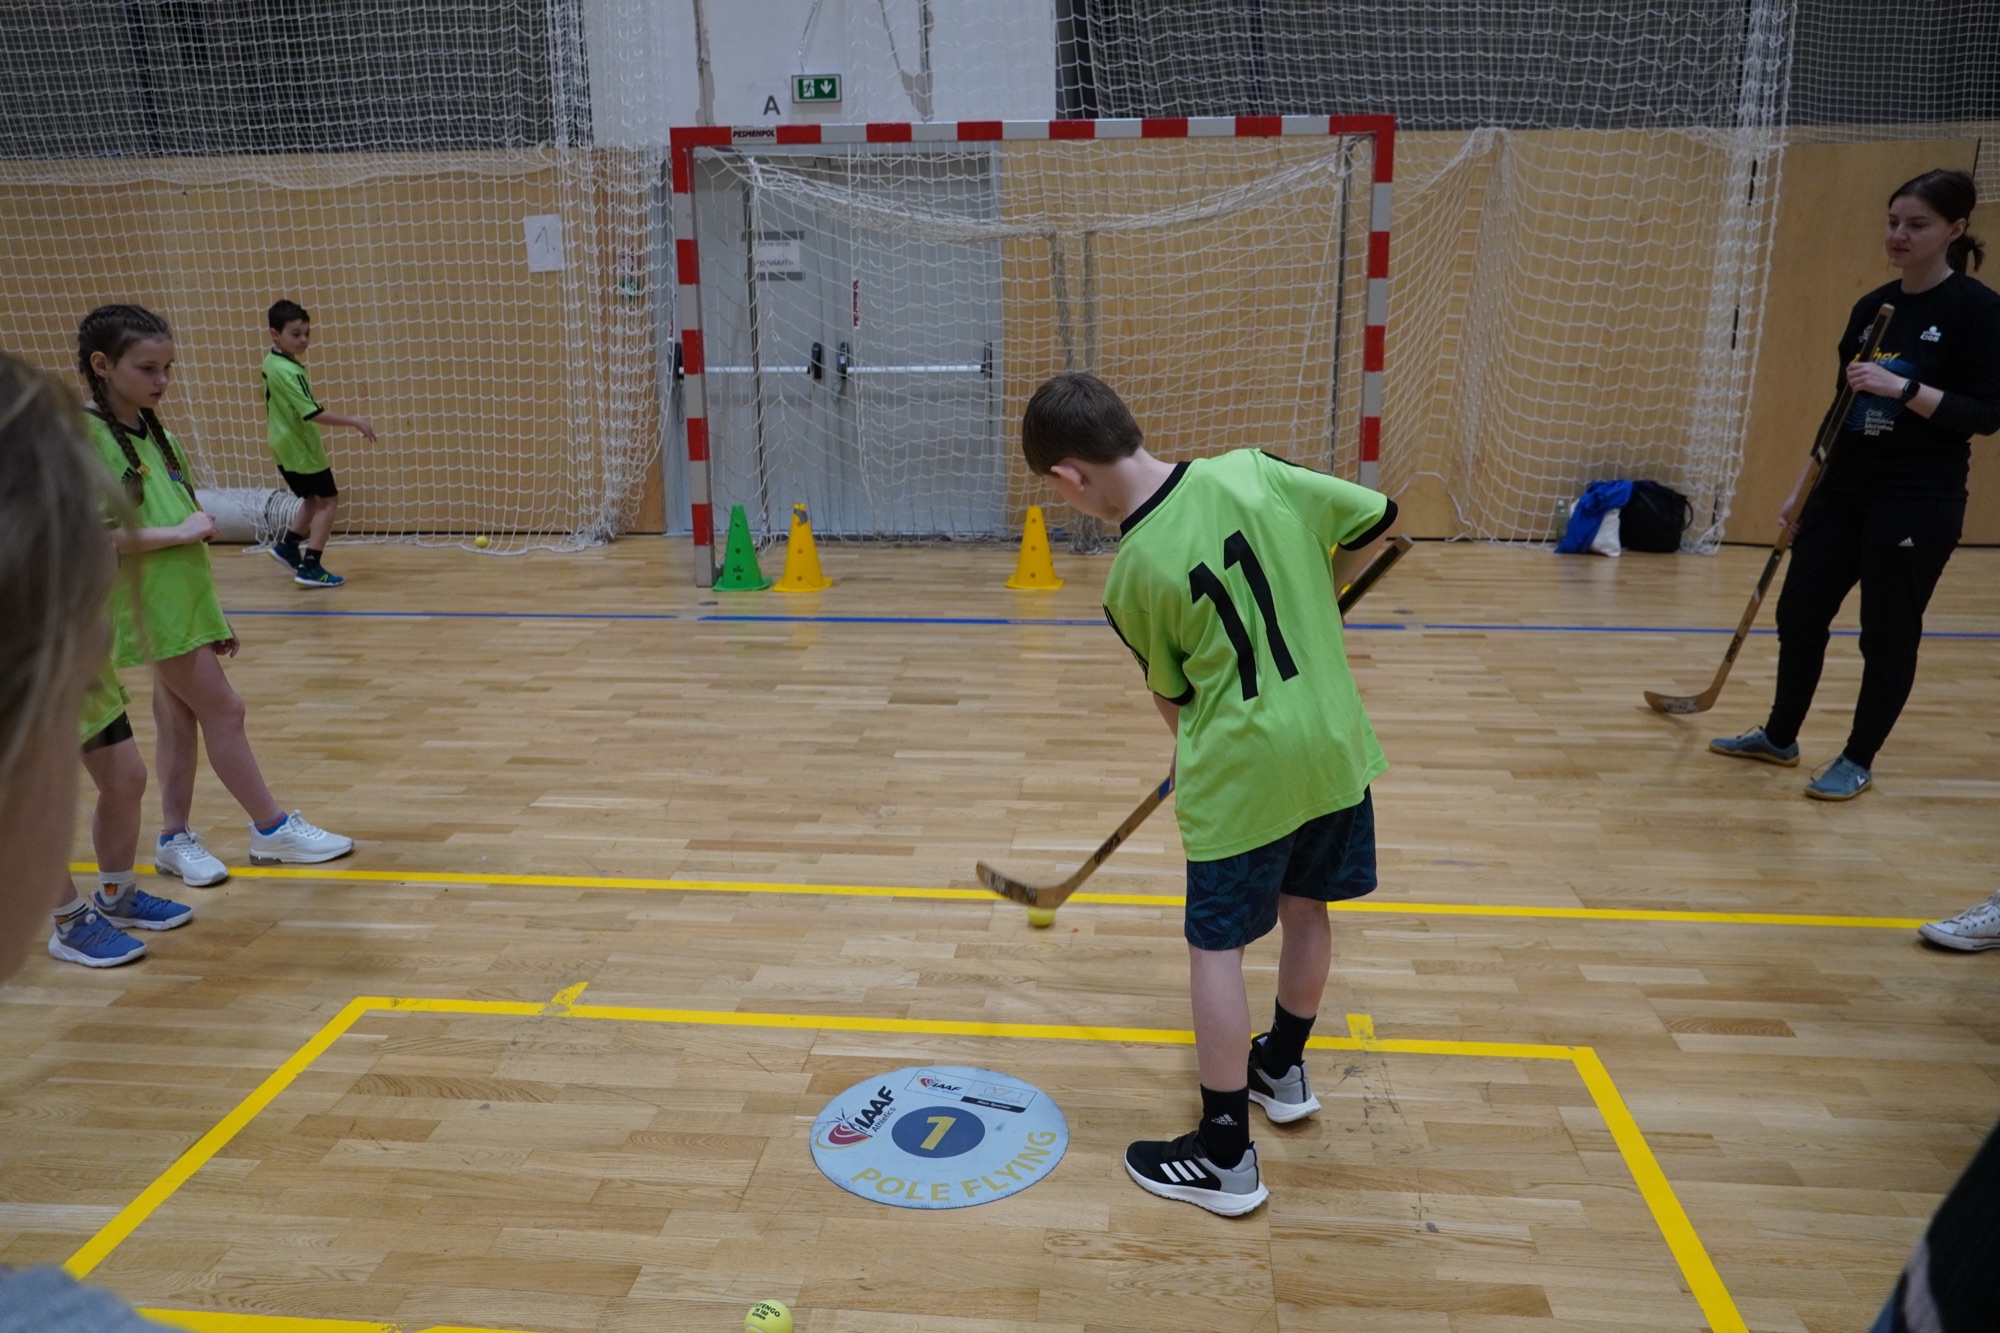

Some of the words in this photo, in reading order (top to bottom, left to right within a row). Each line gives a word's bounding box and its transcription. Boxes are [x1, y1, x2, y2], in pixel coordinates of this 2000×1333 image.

[763, 95, 781, 116] A
[1188, 529, 1299, 702] 11
[932, 1082, 962, 1092] IAAF
[855, 1085, 895, 1130] IAAF
[872, 1106, 897, 1133] Athletics
[920, 1116, 957, 1151] 1
[851, 1167, 951, 1201] POLE
[960, 1131, 1057, 1198] FLYING
